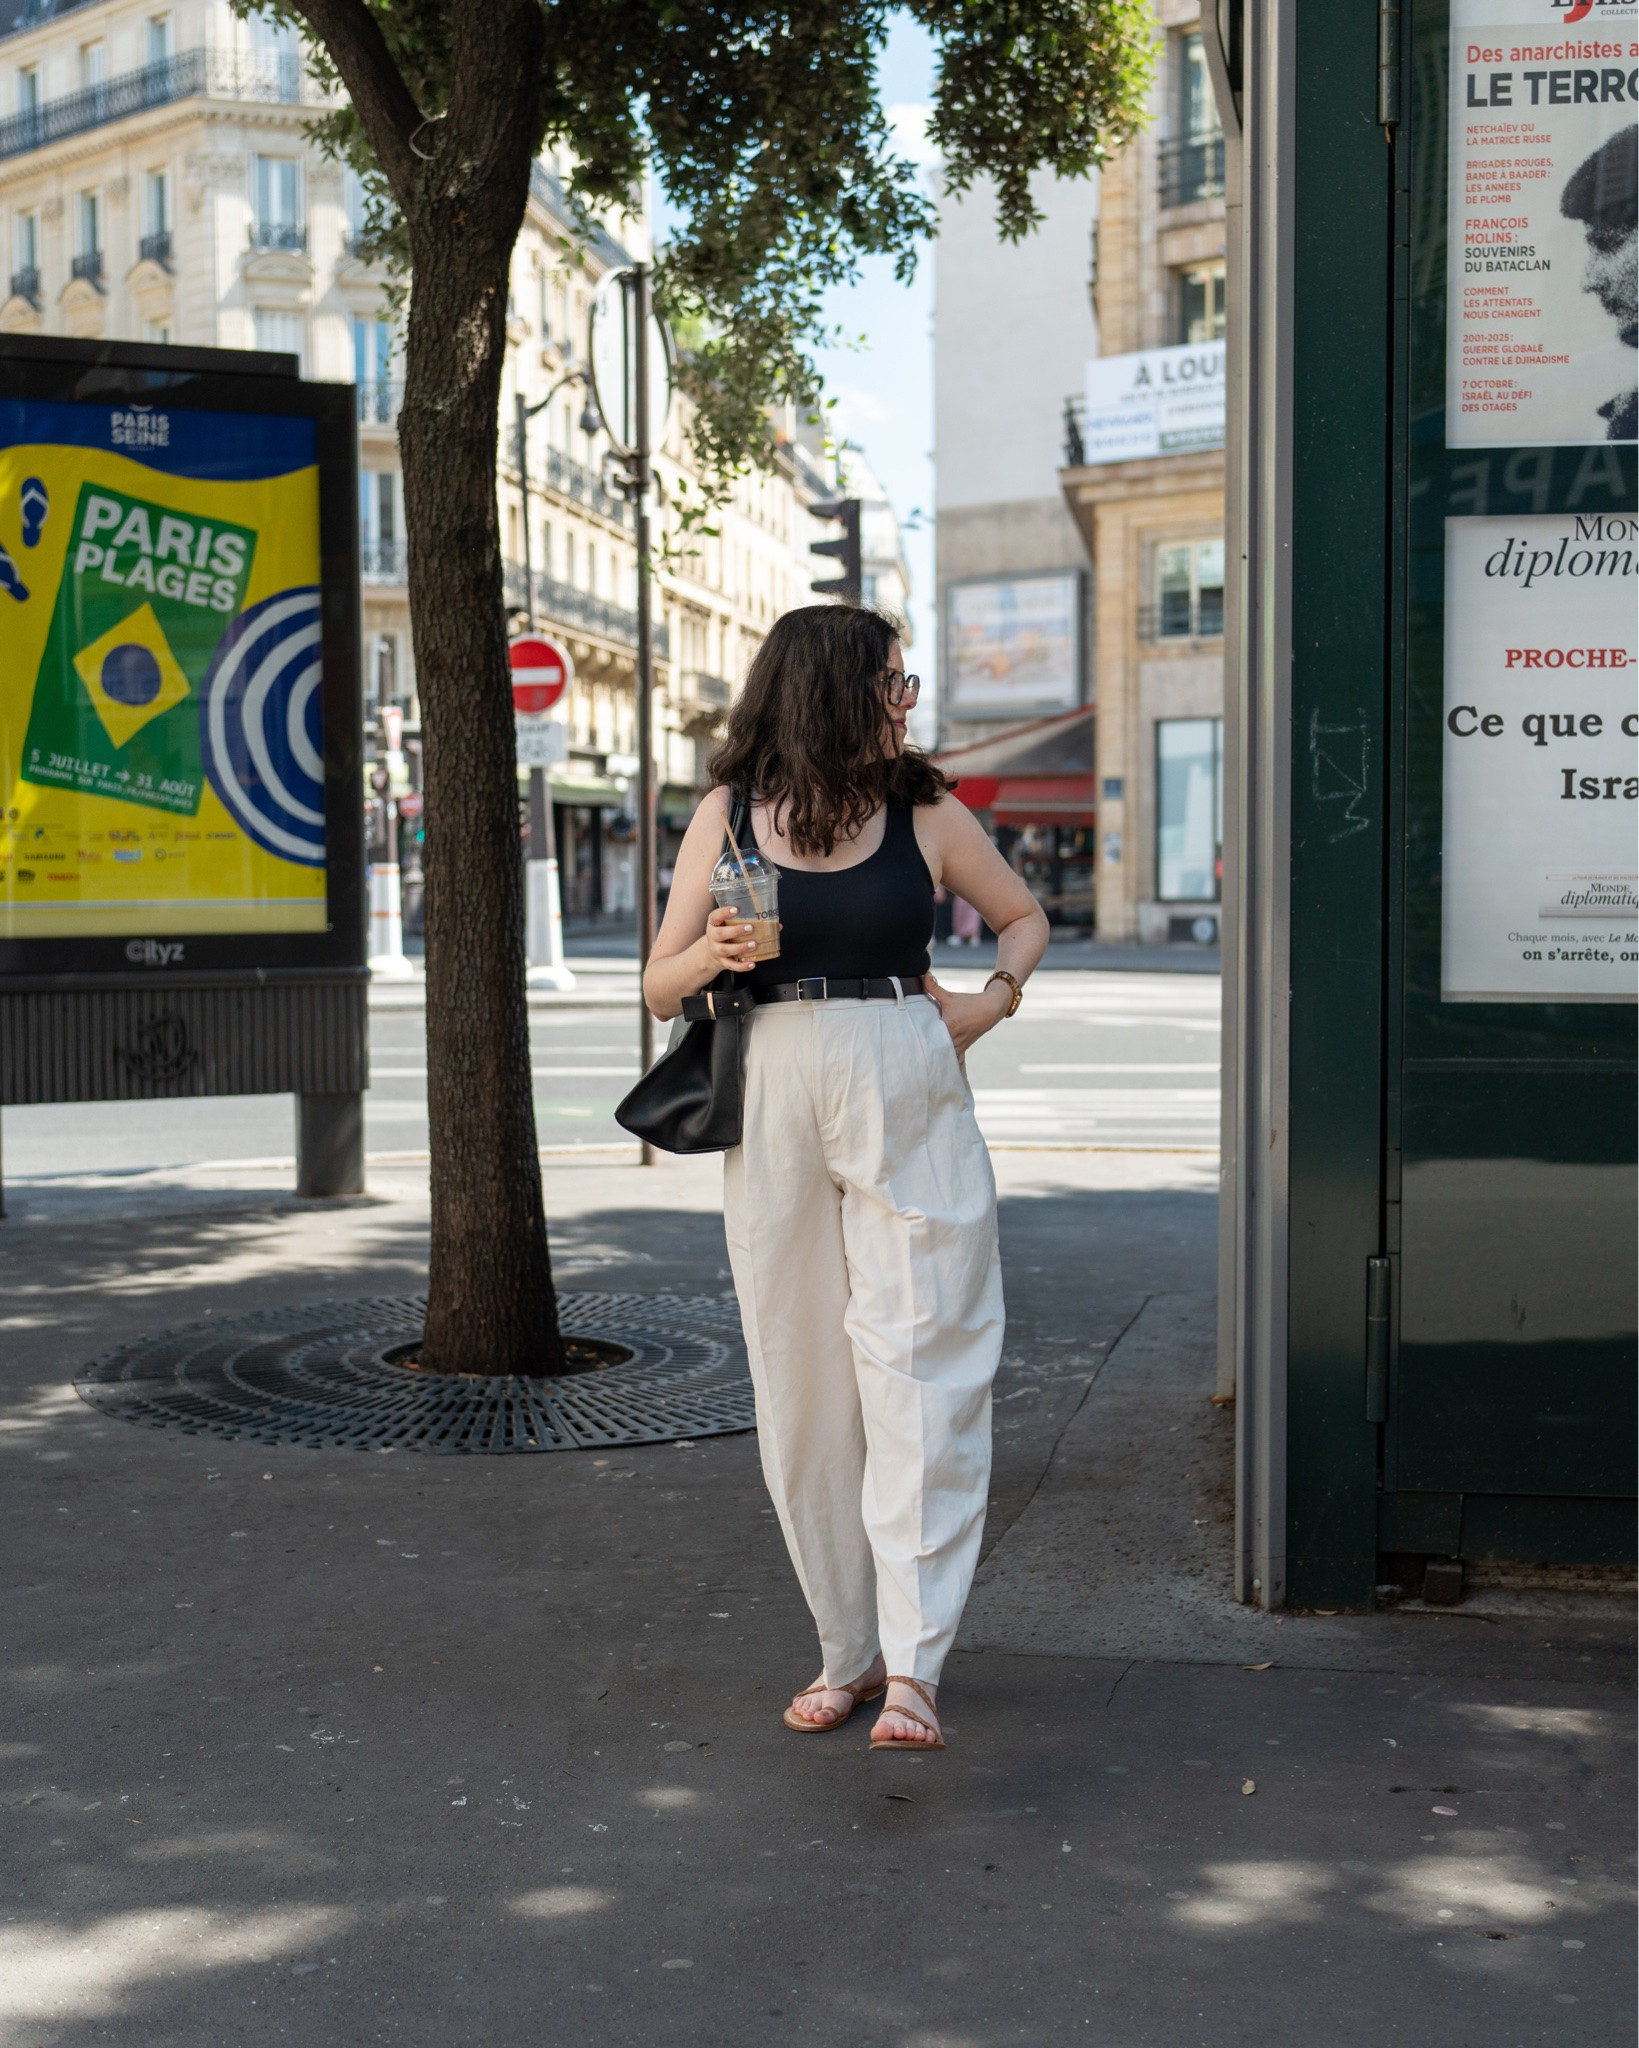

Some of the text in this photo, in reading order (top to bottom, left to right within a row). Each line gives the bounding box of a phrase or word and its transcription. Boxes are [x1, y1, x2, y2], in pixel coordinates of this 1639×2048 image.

[1466, 45, 1503, 63] Des
[1510, 40, 1622, 62] anarchistes
[1467, 73, 1512, 108] LE
[1466, 122, 1535, 134] NETCHAÏEV OU
[1466, 135, 1551, 146] LA MATRICE RUSSE
[1466, 158, 1554, 169] BRIGADES ROUGES,
[1466, 172, 1497, 181] BANDE
[1500, 169, 1507, 179] À
[1466, 181, 1522, 192] LES ANNÉES
[1465, 194, 1511, 204] DE PLOMB
[1465, 217, 1528, 231] FRANÇOIS
[1464, 246, 1535, 258] SOUVENIRS
[1465, 260, 1551, 272] DU BATACLAN
[1463, 287, 1509, 296] COMMENT
[1463, 298, 1533, 308] LES ATTENTATS
[1463, 309, 1541, 319] NOUS CHANGENT
[1462, 344, 1544, 354] GUERRE GLOBALE
[1462, 355, 1570, 366] CONTRE LE DJIHADISME
[1462, 380, 1468, 389] 7
[1462, 389, 1532, 400] ISRAËL AU DÉFI
[1462, 402, 1517, 412] DES OTAGES
[110, 411, 170, 431] PARIS
[111, 427, 170, 447] SEINE
[80, 494, 247, 577] PARIS
[73, 541, 237, 612] PLAGES
[1505, 648, 1638, 668] PROCHE-
[1447, 705, 1504, 737] Ce
[1522, 714, 1602, 746] que
[31, 748, 197, 798] 5 JUILLET 31 AOÛT
[1561, 768, 1638, 800] Isra
[1507, 932, 1548, 944] Chaque
[1551, 933, 1578, 944] mois,
[1582, 934, 1605, 943] avec
[1608, 933, 1621, 943] Le
[1522, 950, 1542, 961] on
[1548, 947, 1614, 964] s’arrête,
